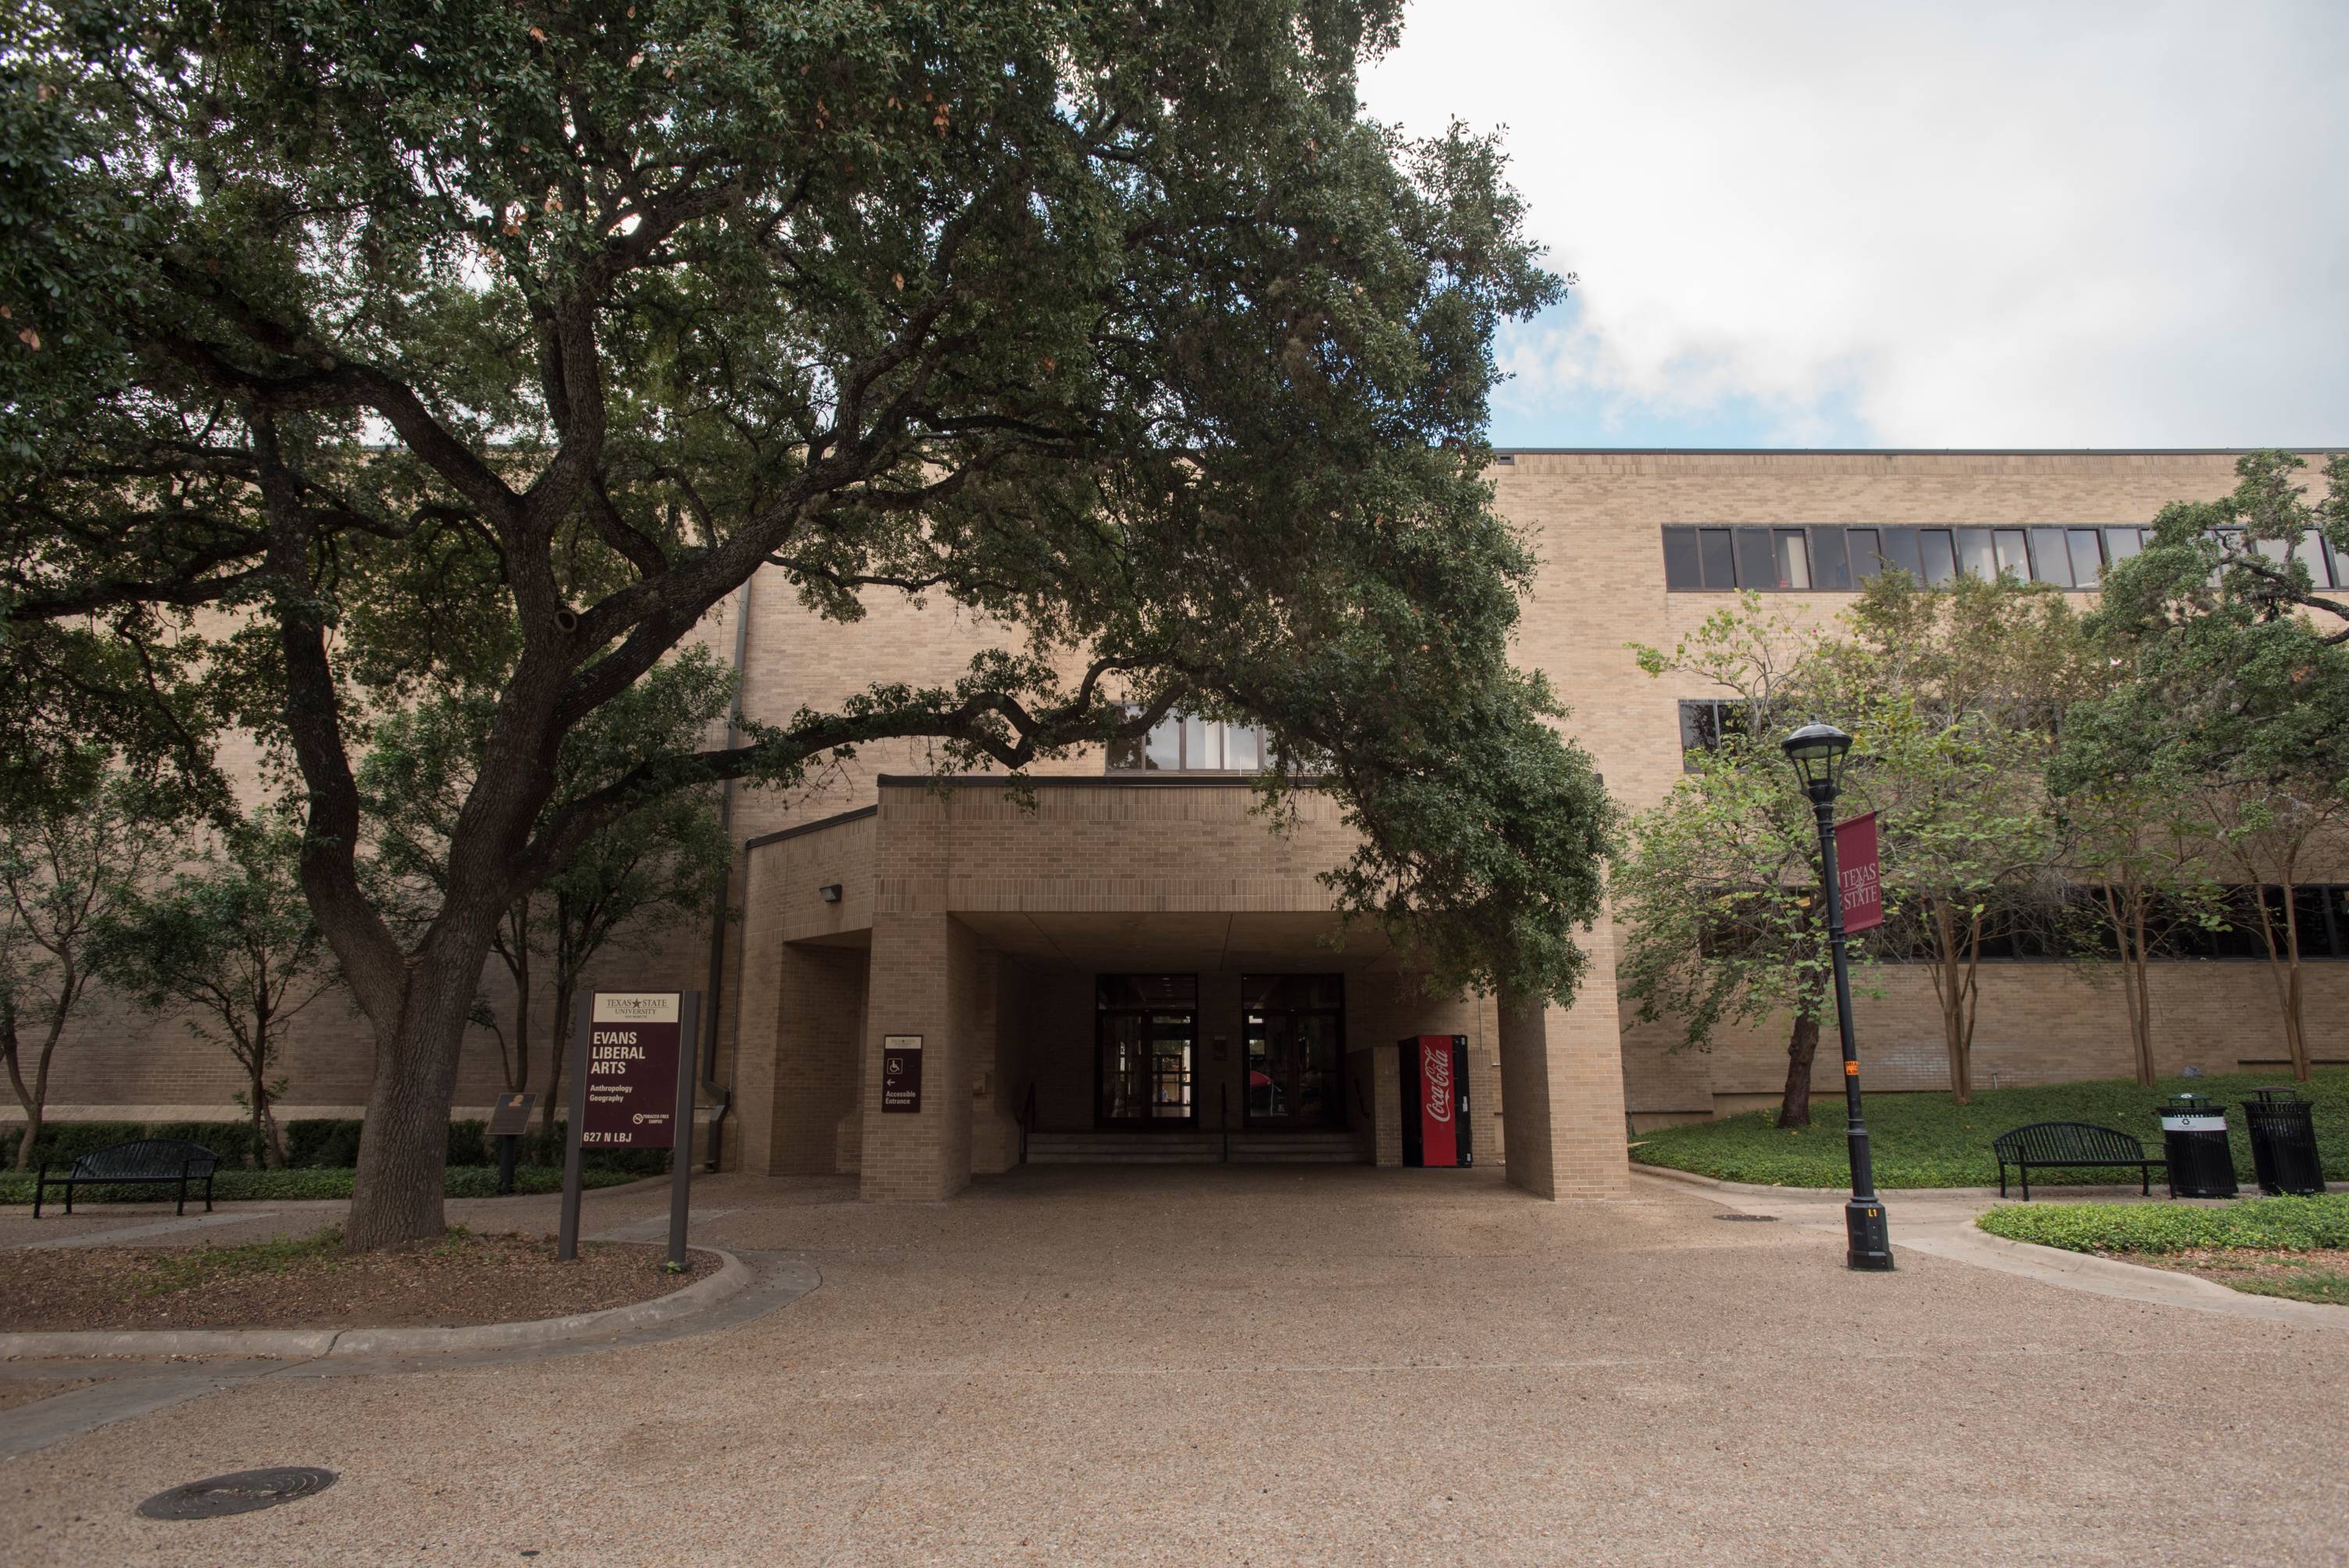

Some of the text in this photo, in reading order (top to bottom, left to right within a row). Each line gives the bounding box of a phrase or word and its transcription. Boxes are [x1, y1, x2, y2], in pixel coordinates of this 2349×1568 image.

[1841, 863, 1877, 888] TEXAS
[1844, 886, 1877, 911] STATE
[593, 1032, 637, 1045] EVANS
[592, 1046, 647, 1060] LIBERAL
[590, 1061, 626, 1074] ARTS
[590, 1085, 633, 1093] Anthropology
[1424, 1045, 1450, 1122] Coca-Cola
[589, 1094, 624, 1103] Geography
[583, 1132, 633, 1142] 627 N LBJ
